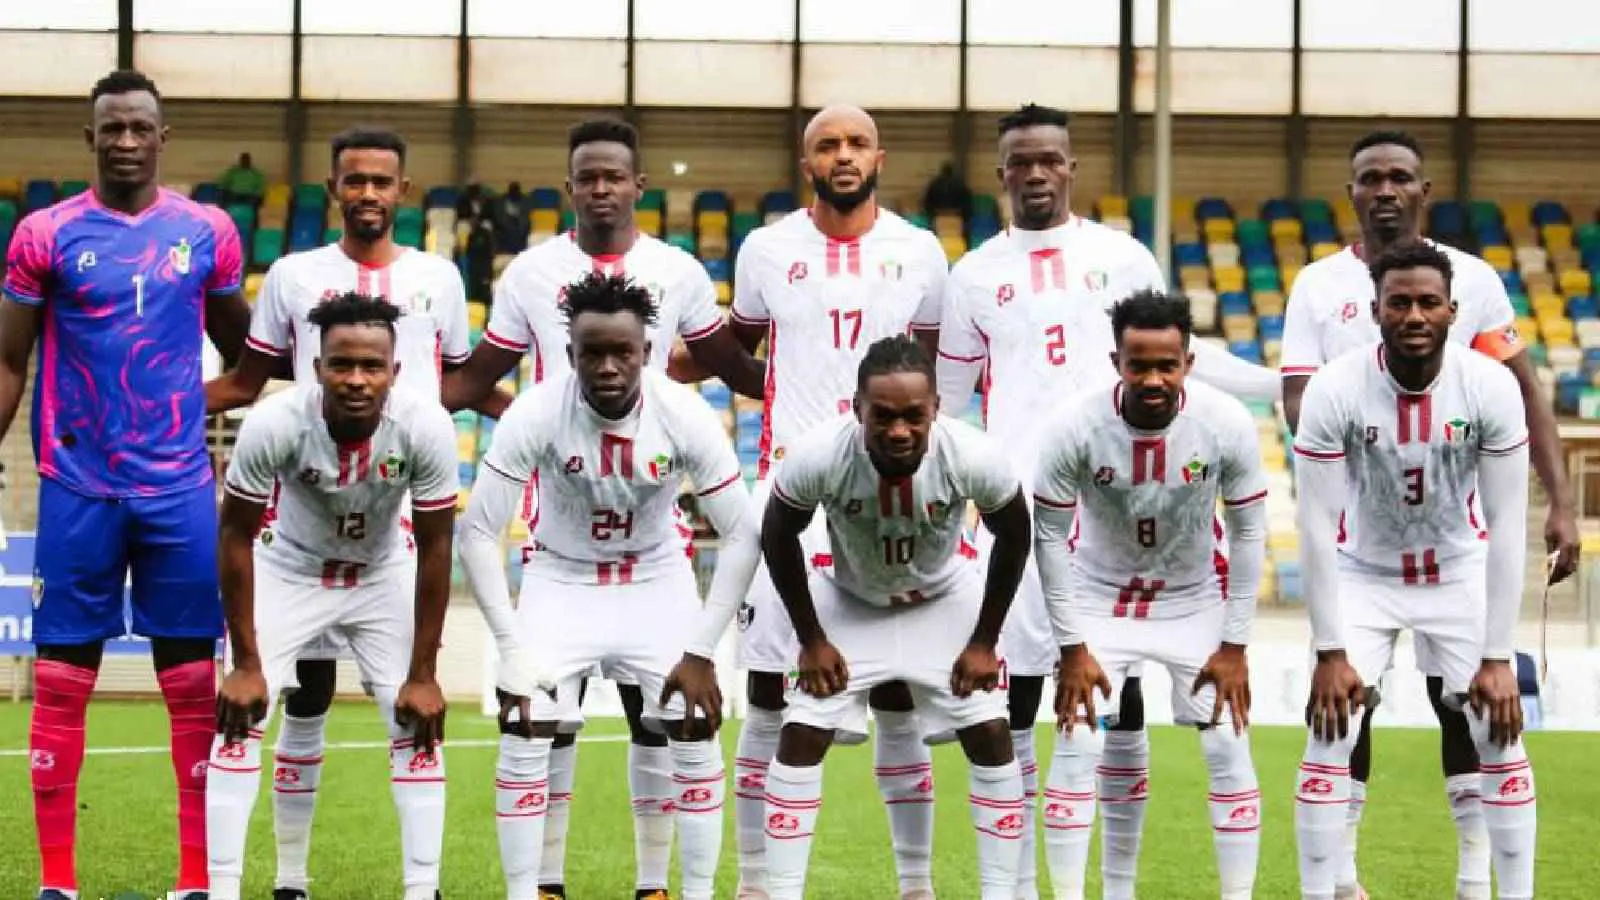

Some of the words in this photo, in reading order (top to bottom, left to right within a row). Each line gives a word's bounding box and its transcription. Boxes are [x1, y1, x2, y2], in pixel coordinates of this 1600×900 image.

[132, 274, 144, 316] 1
[829, 308, 862, 350] 17
[1045, 324, 1066, 366] 2
[1403, 467, 1424, 506] 3
[336, 512, 365, 540] 12
[591, 509, 633, 541] 24
[1138, 516, 1156, 549] 8
[882, 534, 915, 566] 10
